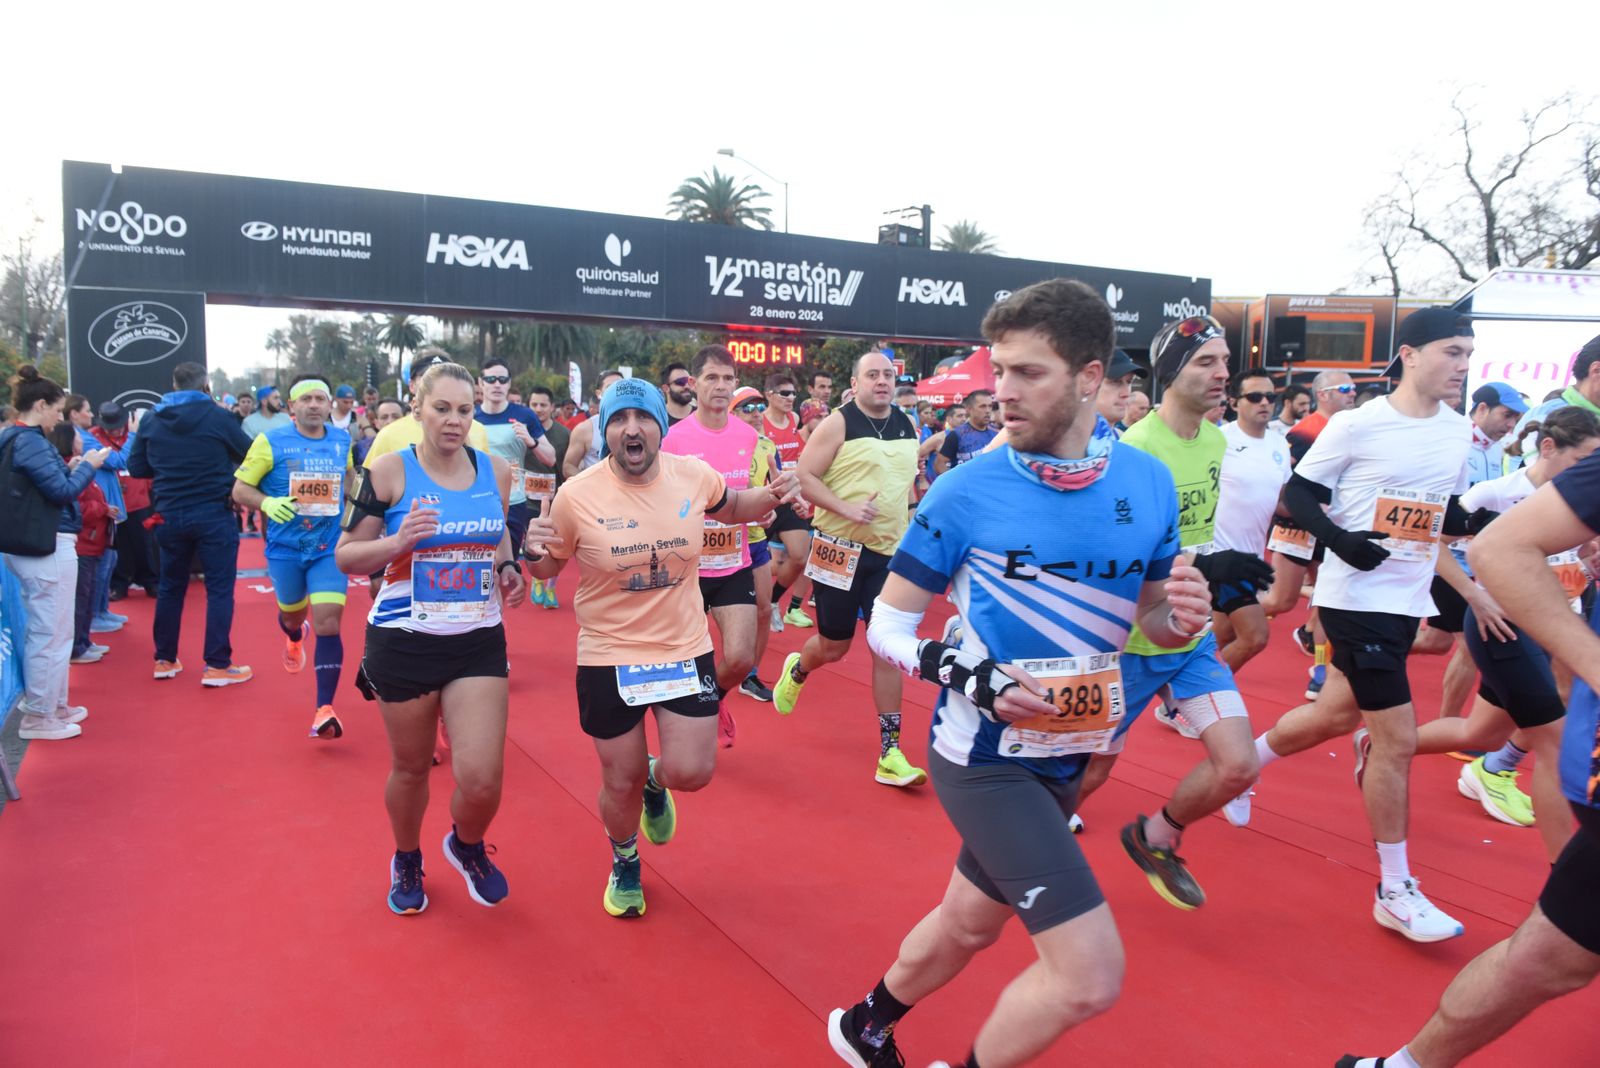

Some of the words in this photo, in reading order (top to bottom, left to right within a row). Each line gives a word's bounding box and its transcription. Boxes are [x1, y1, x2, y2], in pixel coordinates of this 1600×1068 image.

[78, 240, 141, 254] AUNTAMIENTO
[142, 245, 153, 254] DE
[282, 226, 372, 247] HYUNDAI
[282, 243, 339, 258] Hyundauto
[341, 248, 372, 260] Motor
[426, 232, 531, 271] HOKA
[576, 266, 659, 285] quirónsalud
[736, 257, 841, 287] maratón
[582, 285, 624, 298] Healthcare
[624, 288, 652, 300] Partner
[763, 280, 842, 306] sevilla
[898, 276, 966, 307] HOKA
[750, 305, 763, 318] 28
[765, 308, 796, 320] enero
[798, 309, 824, 322] 2024
[728, 341, 802, 364] 00:01:14
[1481, 350, 1582, 388] renf
[298, 483, 329, 497] 4469
[1386, 505, 1431, 530] 4722
[611, 542, 650, 555] Maratón
[656, 537, 687, 549] Sevilla
[816, 545, 845, 566] 4803
[426, 567, 477, 591] 1883
